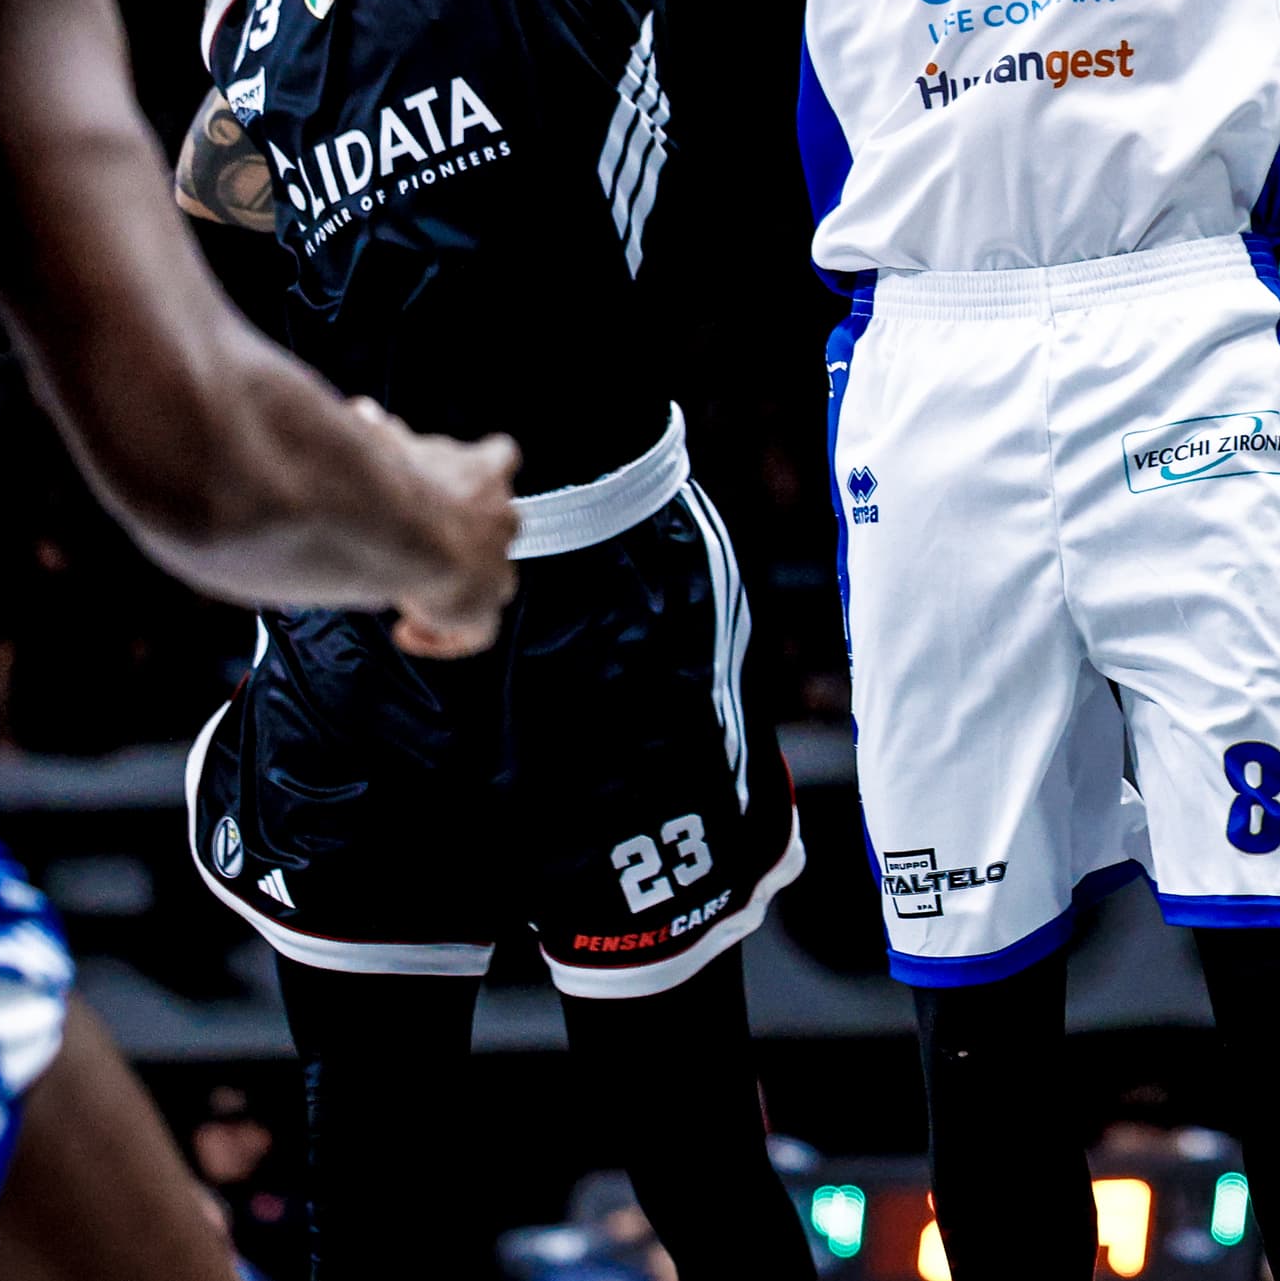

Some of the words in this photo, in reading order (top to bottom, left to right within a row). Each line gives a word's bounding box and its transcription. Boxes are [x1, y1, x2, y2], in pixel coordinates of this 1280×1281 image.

[360, 189, 387, 212] OF
[397, 139, 513, 195] PIONEERS
[1133, 438, 1210, 470] VECCHI
[609, 813, 714, 914] 23
